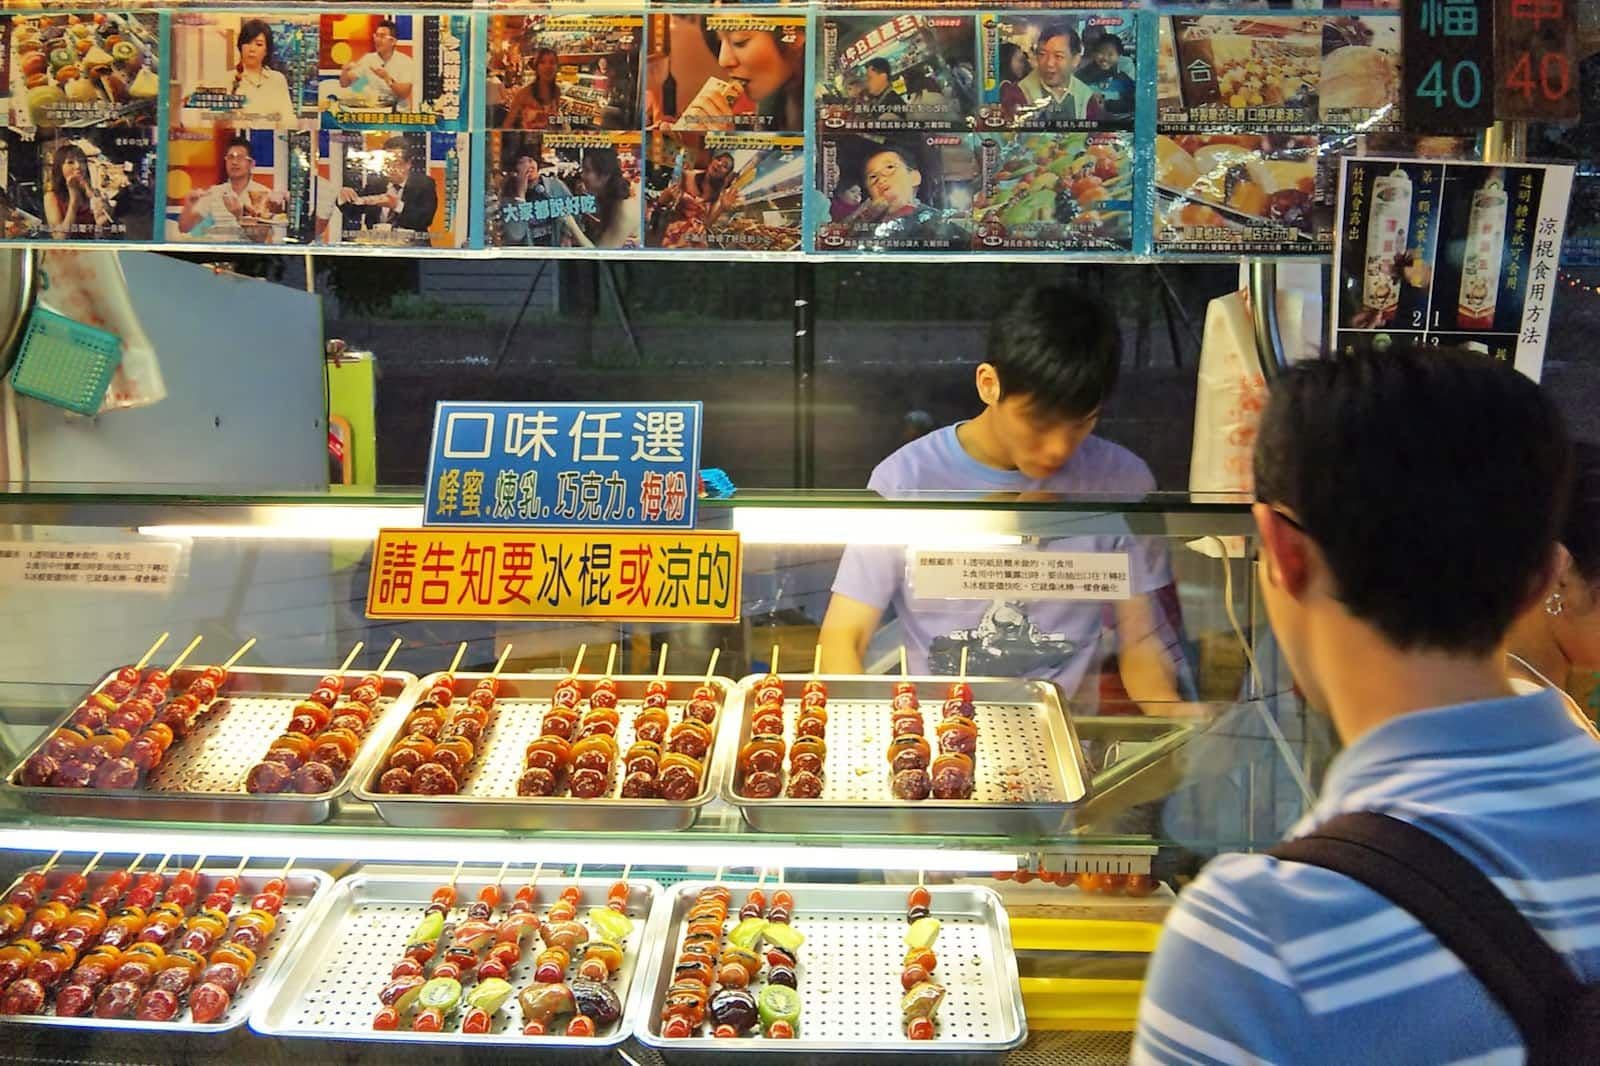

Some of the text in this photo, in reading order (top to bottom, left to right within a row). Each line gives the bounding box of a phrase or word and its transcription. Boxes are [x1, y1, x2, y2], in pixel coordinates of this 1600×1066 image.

[1416, 59, 1482, 109] 40
[1505, 51, 1570, 101] 40
[1521, 217, 1560, 344] 涼棍食用方法
[1412, 310, 1421, 327] 2
[1434, 310, 1440, 327] 1
[443, 410, 687, 463] 口味任選
[379, 541, 731, 608] 請告知要冰棍或涼的
